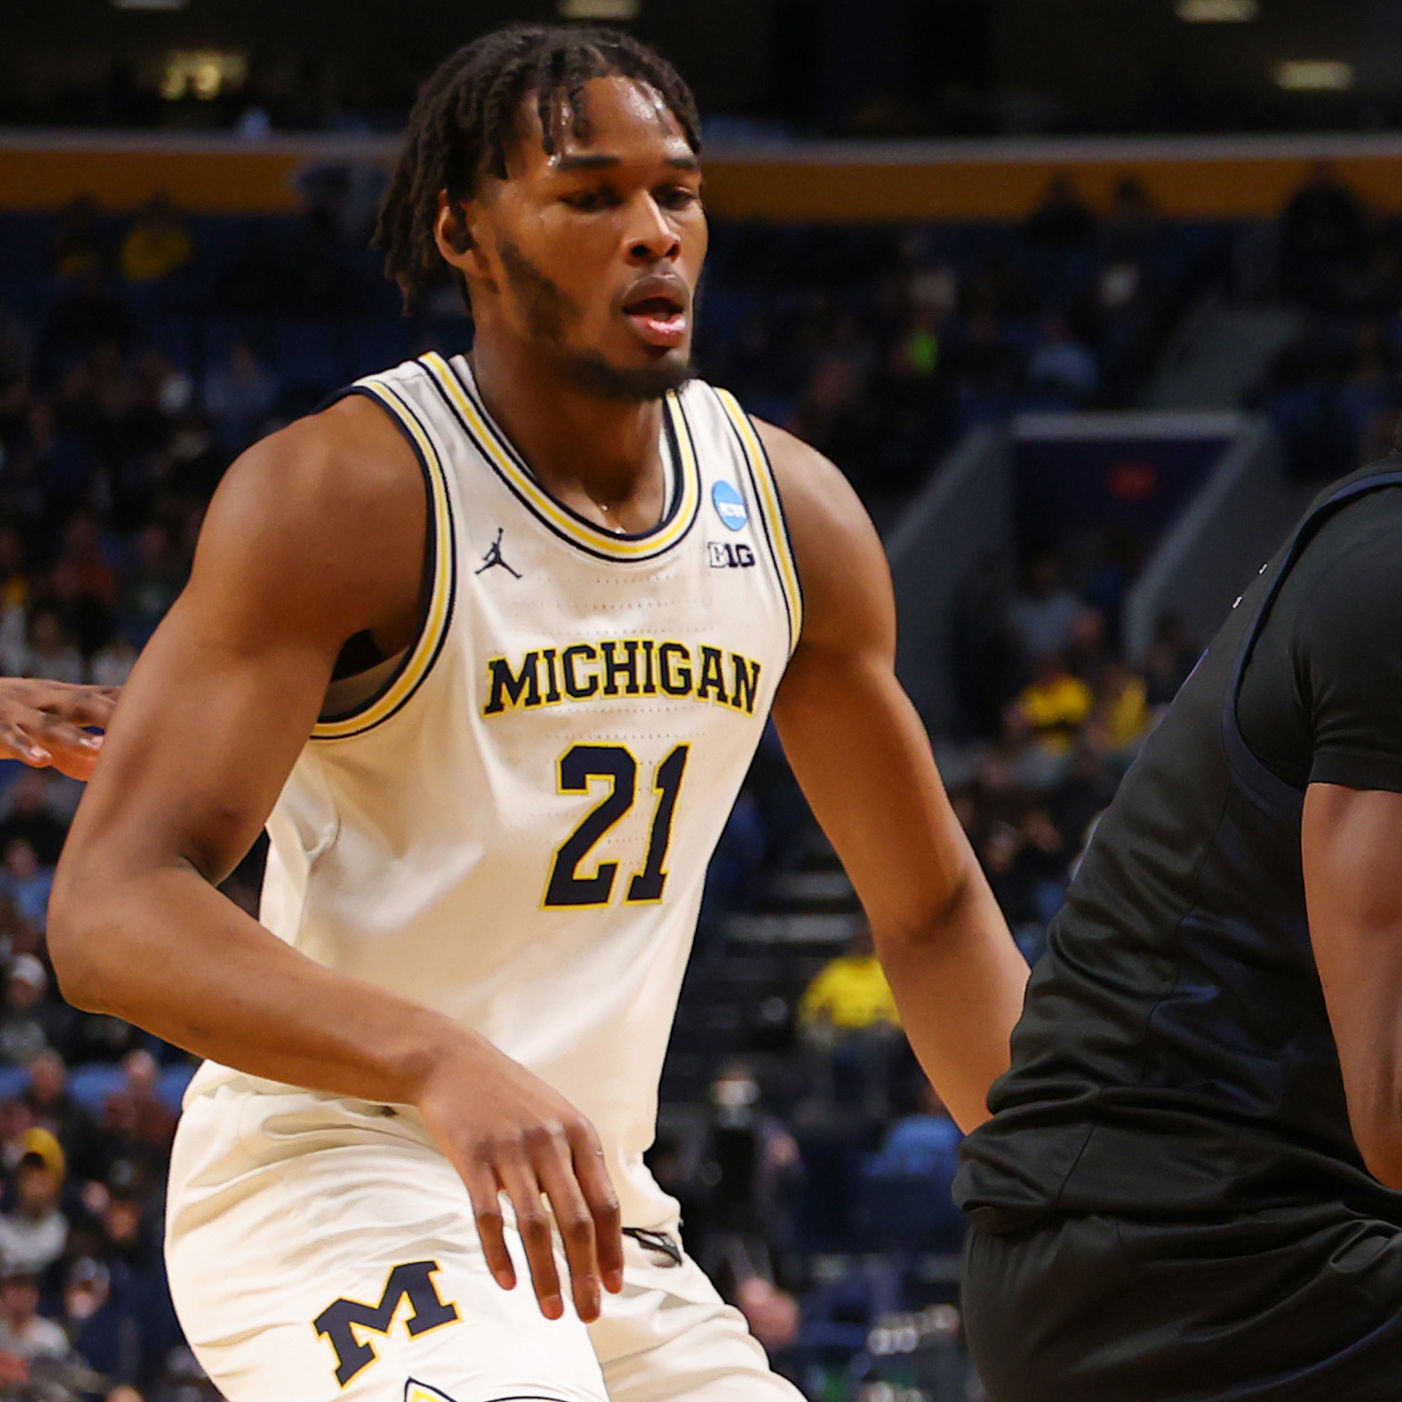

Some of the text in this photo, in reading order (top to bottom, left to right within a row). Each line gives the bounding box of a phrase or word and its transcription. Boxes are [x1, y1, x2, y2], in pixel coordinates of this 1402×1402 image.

[483, 640, 762, 718] MICHIGAN
[541, 742, 691, 911] 21
[312, 1260, 460, 1389] M
